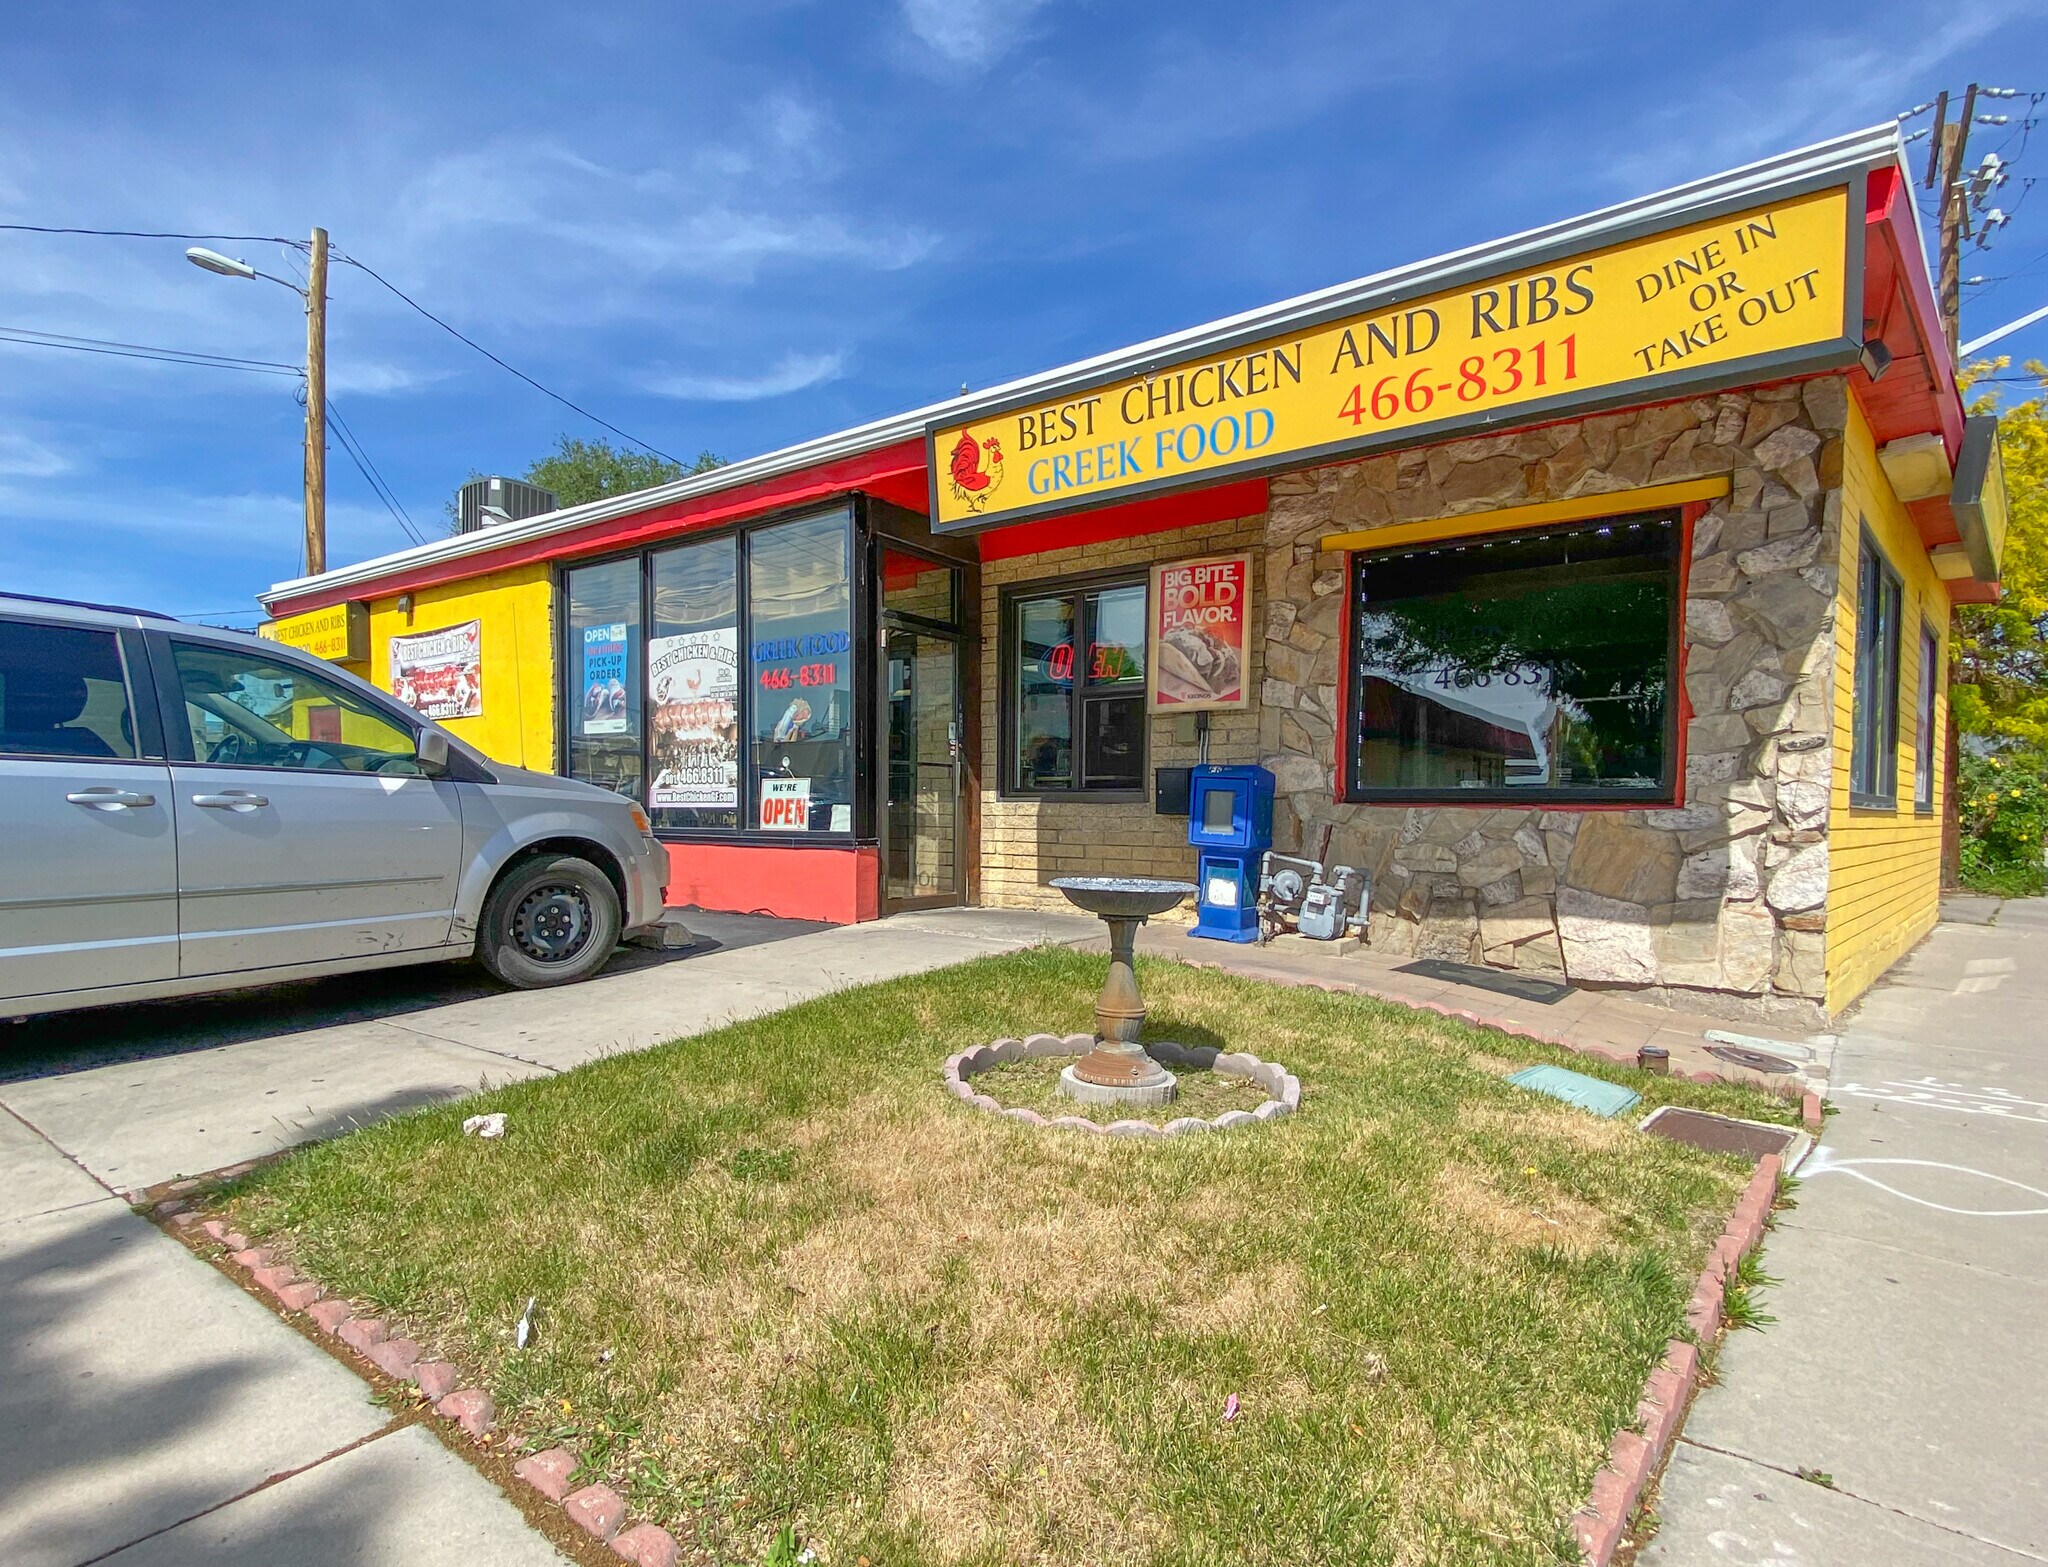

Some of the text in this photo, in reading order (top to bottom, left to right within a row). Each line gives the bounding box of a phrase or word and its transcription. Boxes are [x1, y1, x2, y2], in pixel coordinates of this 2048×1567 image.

[1635, 213, 1777, 304] DINE IN
[1689, 271, 1746, 312] OR
[1633, 268, 1819, 373] TAKE OUT
[1018, 265, 1595, 451] BEST CHICKEN AND RIBS
[1337, 333, 1578, 426] 466-8311
[1027, 408, 1275, 495] GREEK FOOD
[1164, 564, 1239, 589] BIG BITE.
[1164, 581, 1237, 612] BOLD
[288, 621, 315, 640] CHICKEN
[315, 617, 330, 634] AND
[330, 614, 345, 630] RIBS
[1163, 606, 1238, 628] FLAVOR.
[314, 636, 346, 654] 466-8311
[402, 642, 418, 662] BEST
[418, 638, 446, 660] CHICKEN
[452, 633, 469, 653] RIBS
[585, 628, 609, 643] OPEN
[588, 655, 622, 668] PICK-UP
[650, 644, 737, 678] BEST CHICKEN & RIBS
[752, 638, 801, 662] GREEK
[589, 668, 621, 680] ORDERS
[760, 663, 835, 690] 466-8311
[680, 766, 724, 785] 466.8311
[772, 783, 798, 792] WE'RE
[763, 797, 806, 825] OPEN
